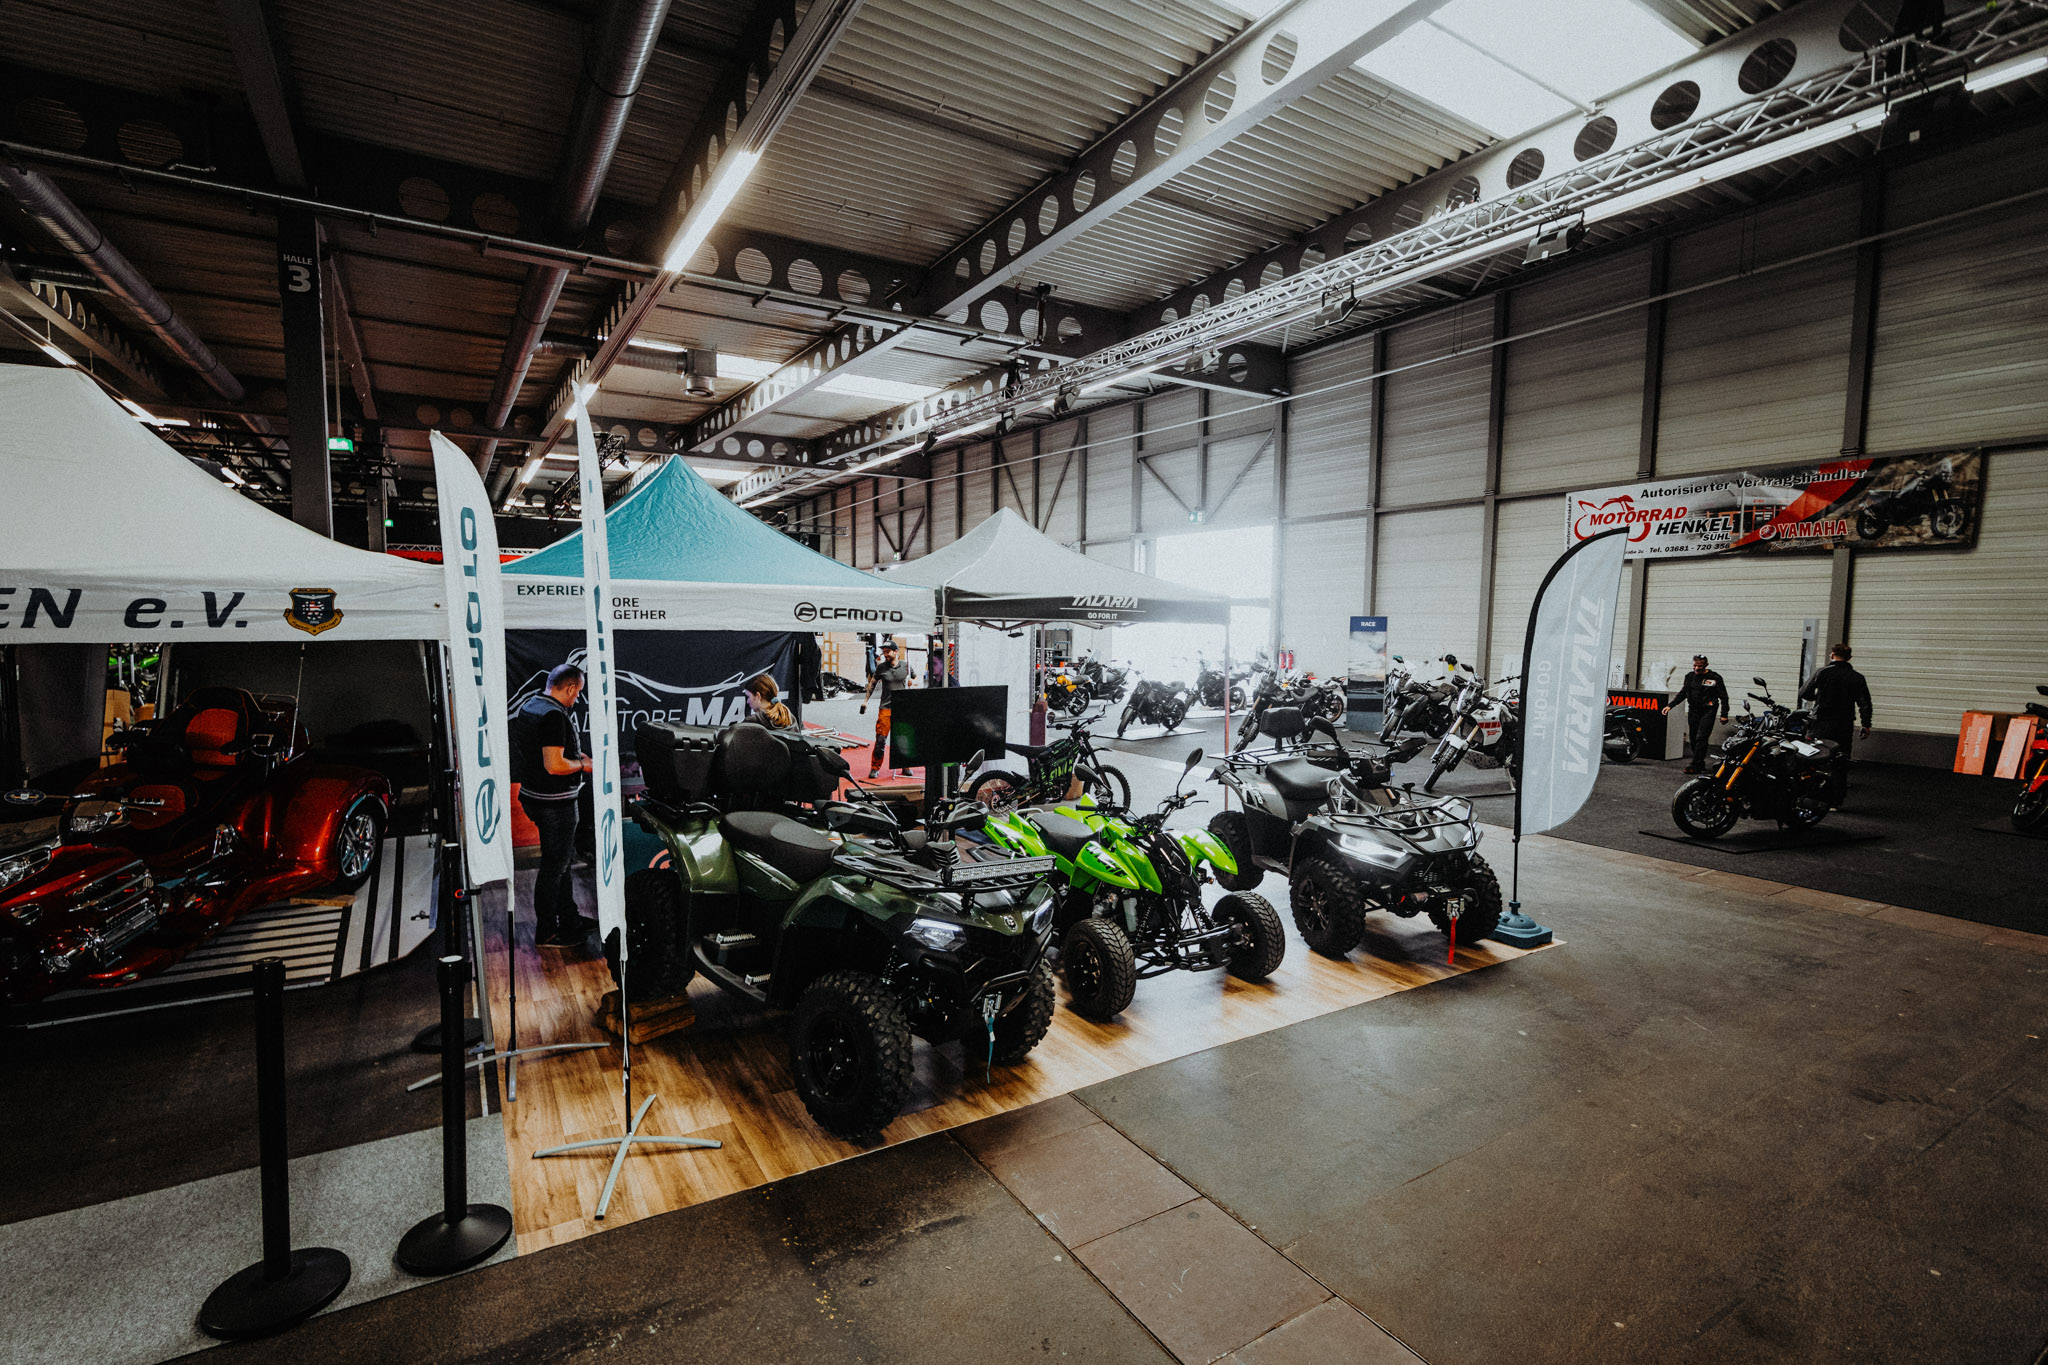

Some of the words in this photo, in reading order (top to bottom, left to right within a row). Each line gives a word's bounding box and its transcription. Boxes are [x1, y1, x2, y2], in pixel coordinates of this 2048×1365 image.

[283, 254, 313, 265] HALLE
[288, 265, 311, 292] 3
[1641, 482, 1730, 498] Autorisierter
[1736, 469, 1867, 488] Vertragshändler
[1590, 506, 1688, 526] MOTORRAD
[1655, 517, 1733, 535] HENKEL
[1778, 520, 1848, 538] YAMAHA
[1703, 533, 1731, 541] SUHL
[517, 585, 585, 596] EXPERIEN
[612, 597, 640, 608] ORE
[1072, 595, 1139, 608] TALARIA
[124, 591, 248, 629] e.V.
[613, 609, 666, 620] GETHER
[819, 607, 903, 622] CFMOTO
[1537, 660, 1552, 685] GO
[1562, 597, 1604, 774] TALARIA
[1534, 689, 1549, 720] FOR
[1611, 696, 1658, 710] YAMAHA
[1532, 725, 1546, 740] IT
